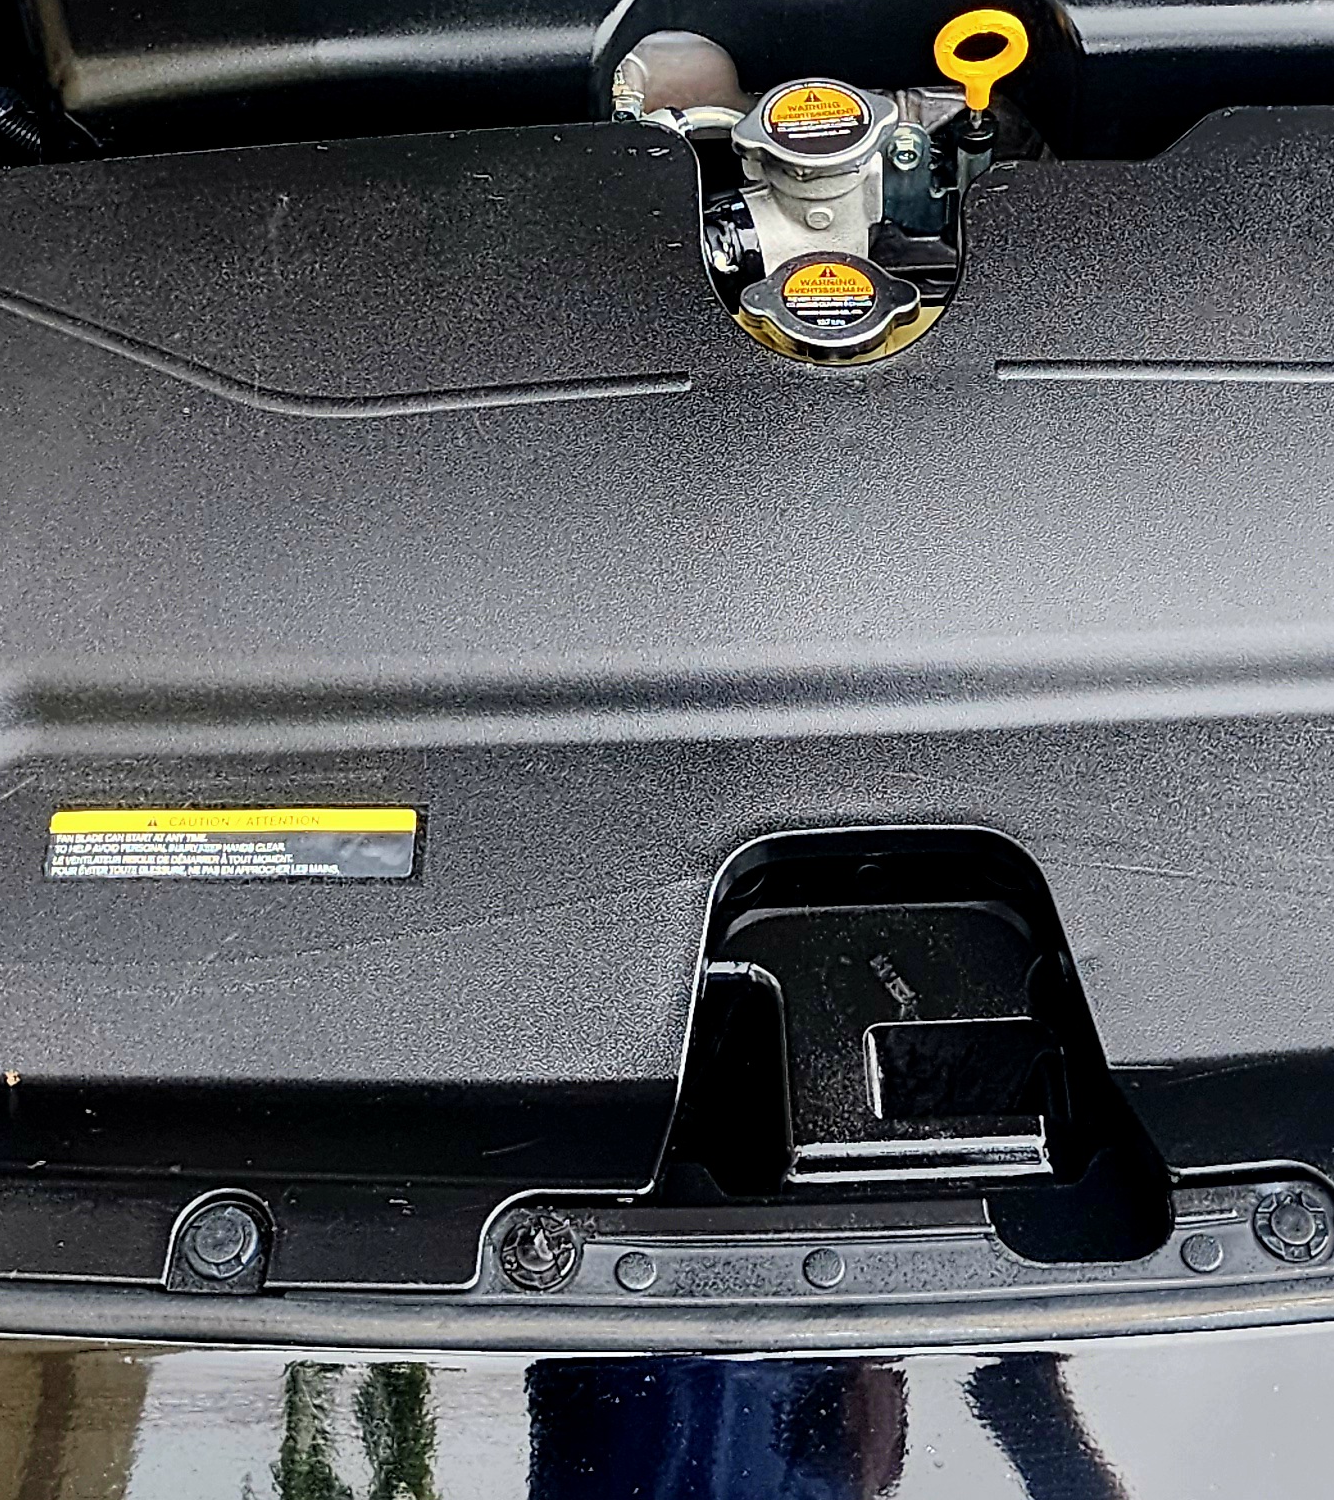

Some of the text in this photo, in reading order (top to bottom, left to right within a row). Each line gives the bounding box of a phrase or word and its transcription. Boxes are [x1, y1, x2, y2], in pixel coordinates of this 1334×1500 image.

[800, 278, 856, 286] WARNING
[169, 816, 229, 827] CAUTION
[246, 815, 320, 826] ATTENTION
